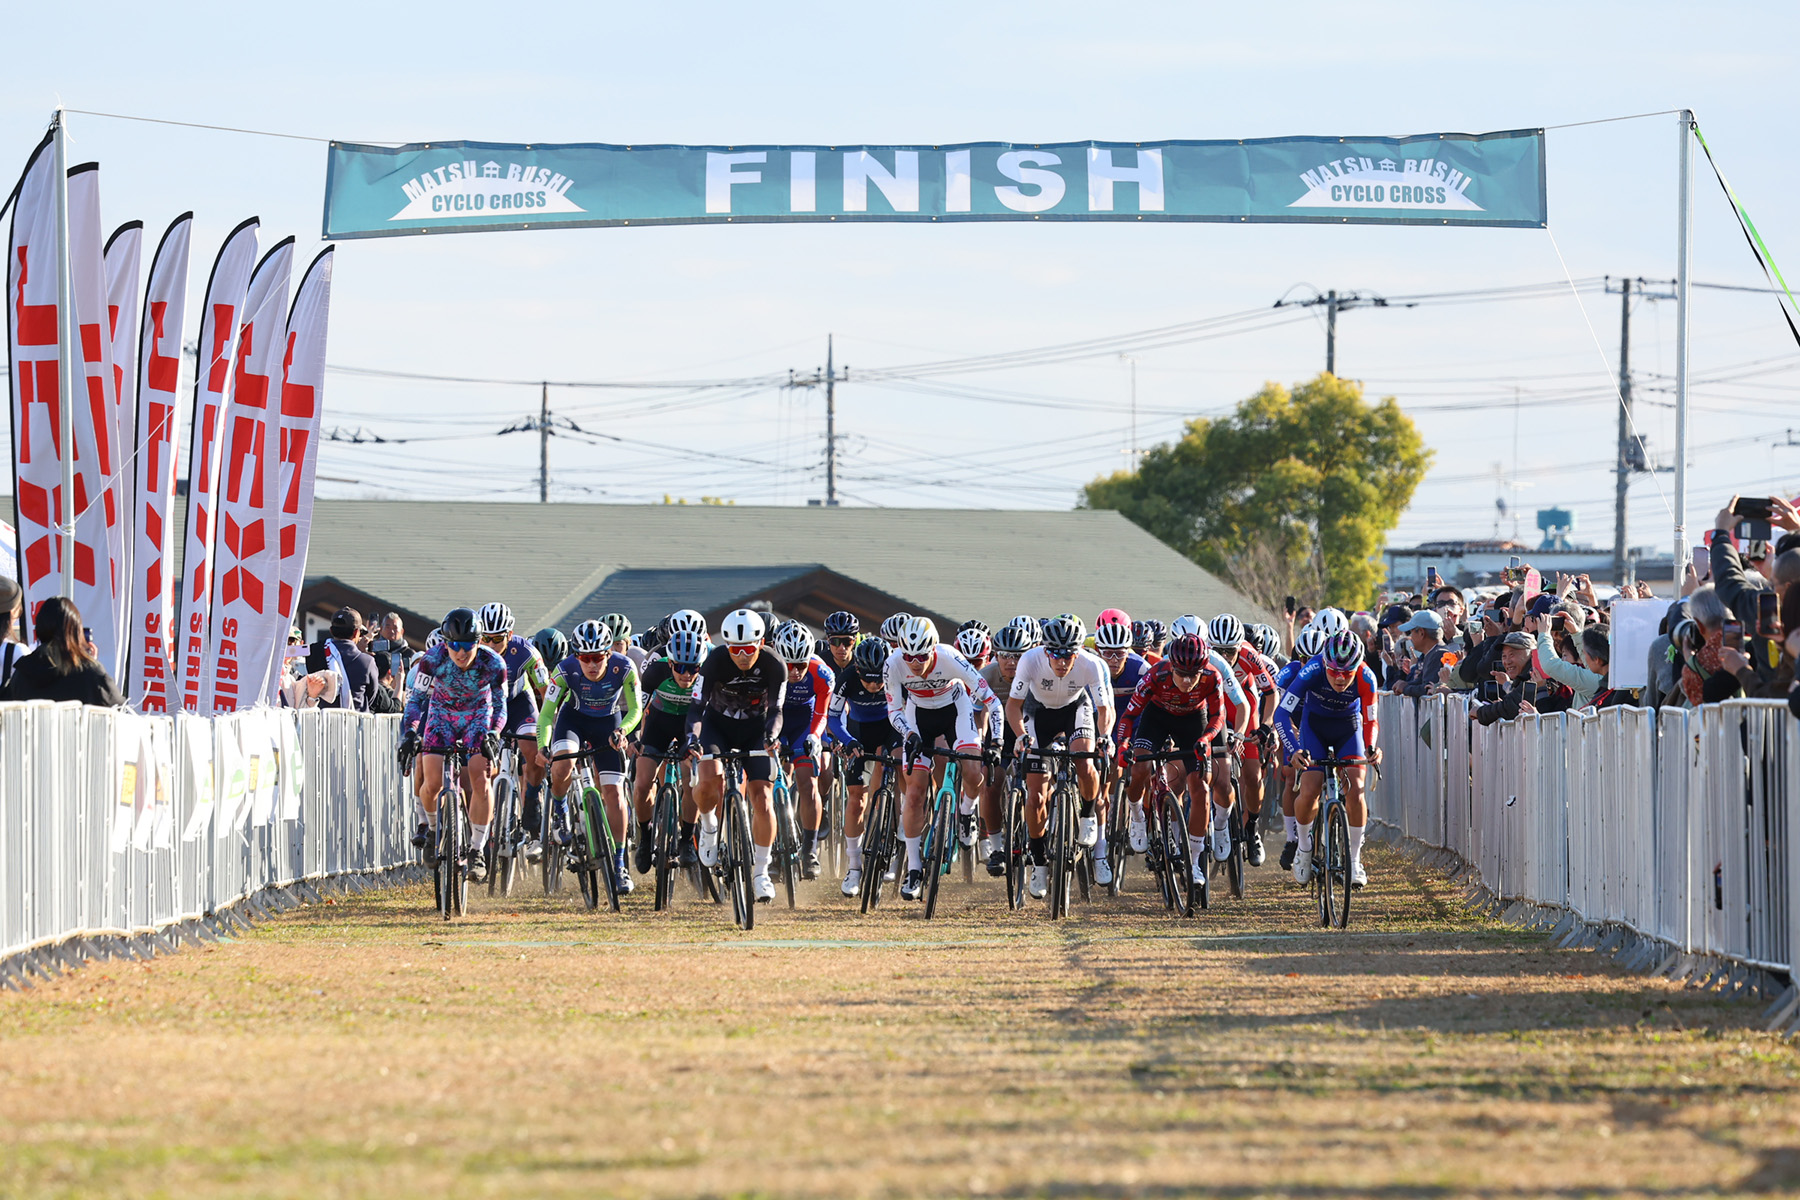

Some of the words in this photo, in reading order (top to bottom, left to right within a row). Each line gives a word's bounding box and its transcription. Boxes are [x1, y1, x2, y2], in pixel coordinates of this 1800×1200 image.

[401, 160, 477, 200] MATSU
[506, 162, 575, 193] BUSHI
[706, 148, 1165, 213] FINISH
[1300, 157, 1375, 189] MATSU
[1404, 158, 1472, 194] BUSHI
[432, 194, 485, 212] CYCLO
[489, 190, 546, 210] CROSS
[1331, 184, 1385, 202] CYCLO
[1389, 185, 1446, 204] CROSS
[142, 612, 166, 712] SERIE
[184, 612, 202, 711] SERIE
[213, 617, 238, 717] SERIE
[1300, 662, 1319, 678] KMC
[418, 674, 430, 687] 10
[1016, 681, 1024, 691] 3
[1226, 678, 1233, 687] 5
[1256, 673, 1268, 684] 16
[548, 685, 556, 695] 9
[834, 696, 842, 706] 7
[1286, 695, 1295, 706] 8
[1275, 721, 1295, 753] BIORACER
